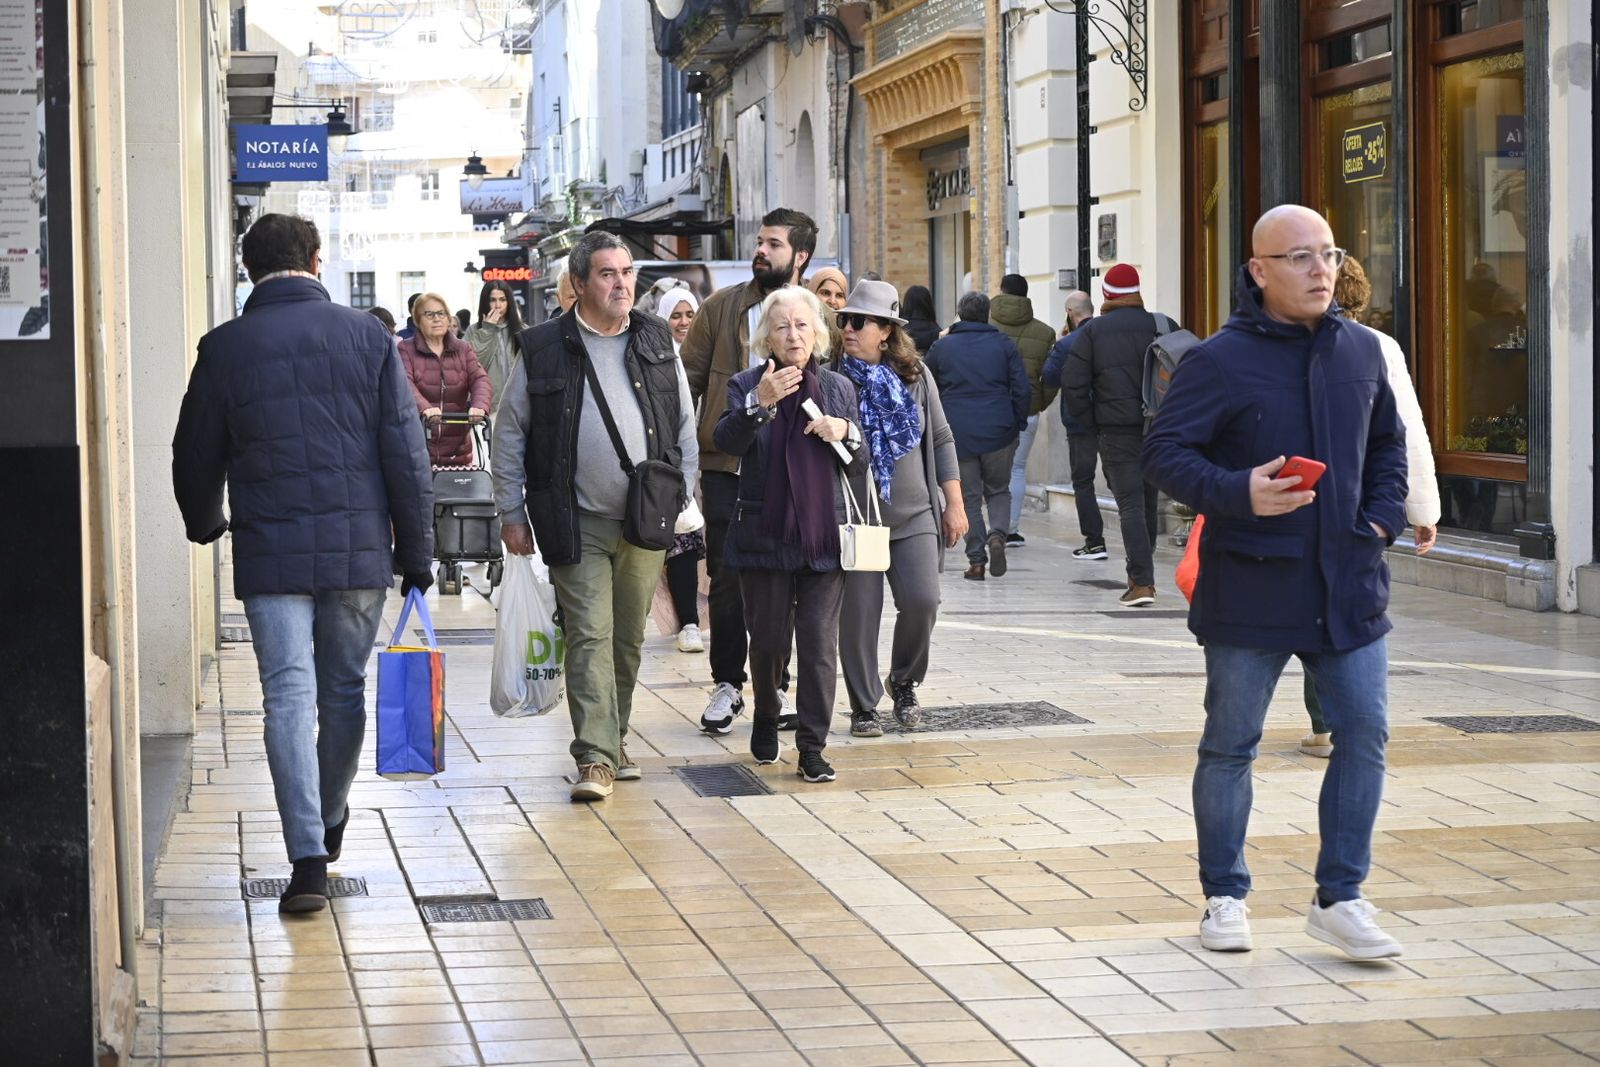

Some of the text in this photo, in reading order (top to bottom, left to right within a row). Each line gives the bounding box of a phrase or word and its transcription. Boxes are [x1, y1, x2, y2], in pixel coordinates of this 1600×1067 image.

[246, 139, 319, 153] NOTARÍA
[1346, 134, 1362, 151] OFERTA
[1365, 135, 1384, 164] -25%
[1345, 156, 1363, 174] RELOJES
